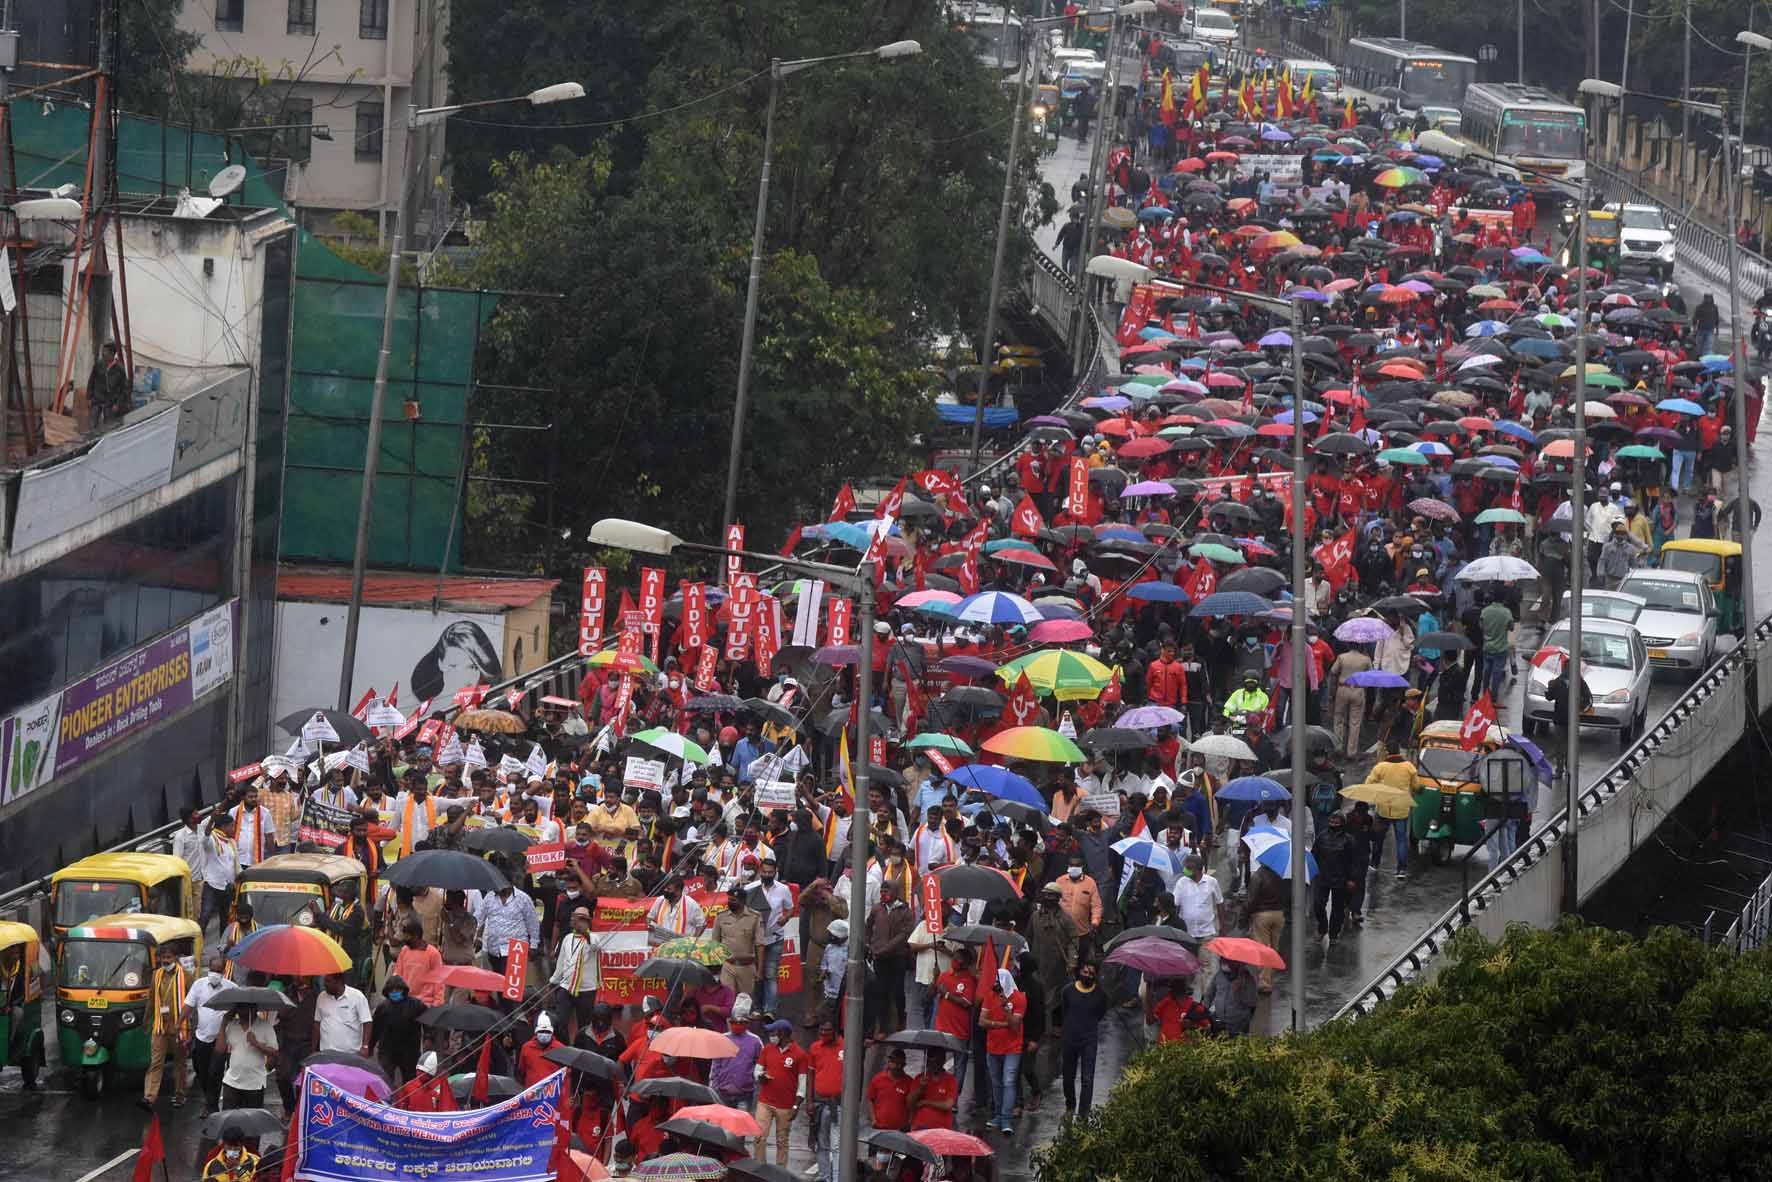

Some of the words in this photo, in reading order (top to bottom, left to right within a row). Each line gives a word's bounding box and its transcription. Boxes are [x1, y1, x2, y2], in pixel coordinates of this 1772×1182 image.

[1073, 459, 1085, 515] AITUC
[580, 569, 604, 656] AIUTUC
[643, 571, 659, 633] AIDYO
[688, 585, 701, 647] AIDYO
[727, 575, 754, 660] AIUTUC
[61, 693, 113, 745] PIONEER
[115, 651, 189, 716] ENTERPRISES
[85, 730, 106, 750] Dealers
[149, 698, 162, 714] Tools
[926, 877, 939, 932] AITUC
[506, 942, 524, 999] AITUC
